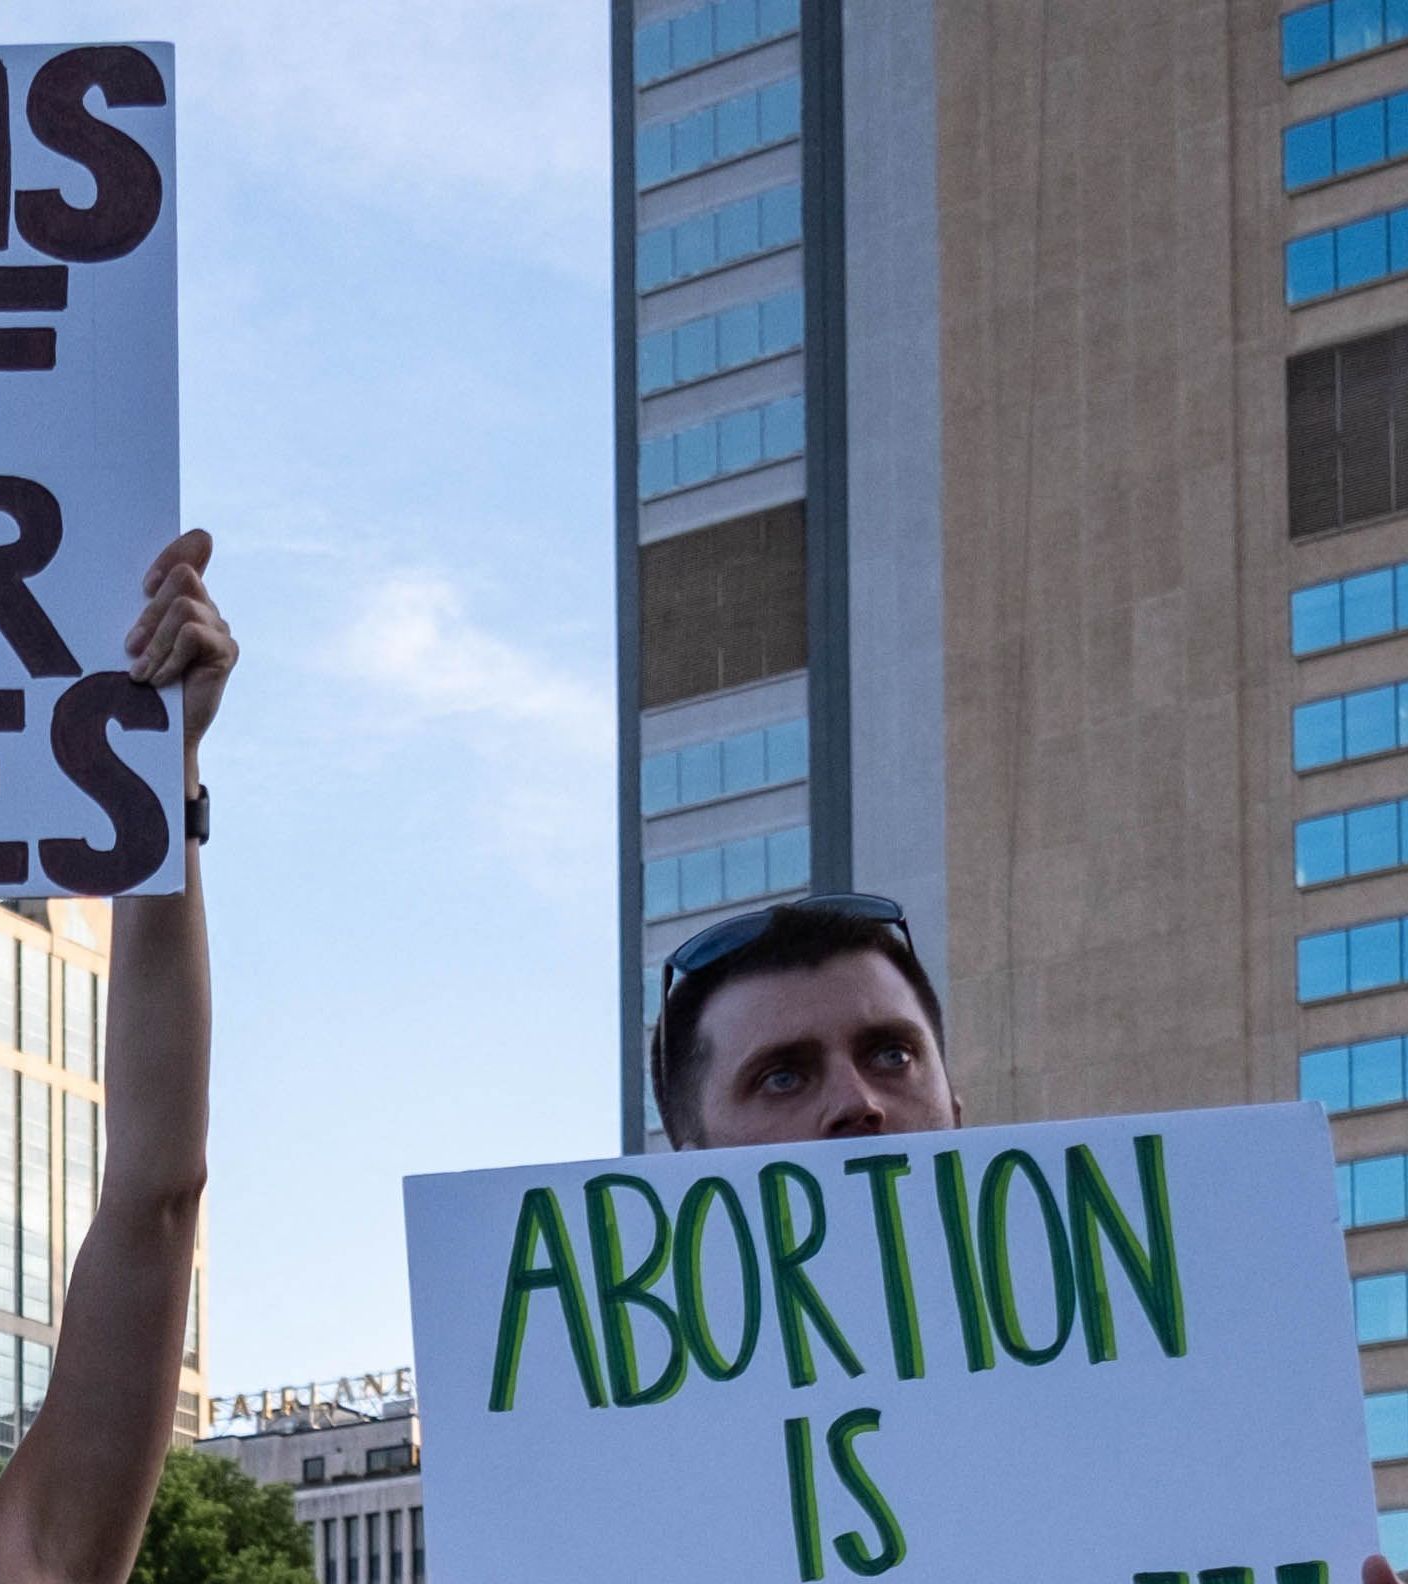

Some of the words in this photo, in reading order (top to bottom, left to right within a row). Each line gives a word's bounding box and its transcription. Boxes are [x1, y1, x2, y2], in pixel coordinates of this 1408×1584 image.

[488, 1133, 1187, 1413] ABORTION
[208, 1367, 413, 1428] FAIRLANE
[784, 1407, 907, 1582] IS
